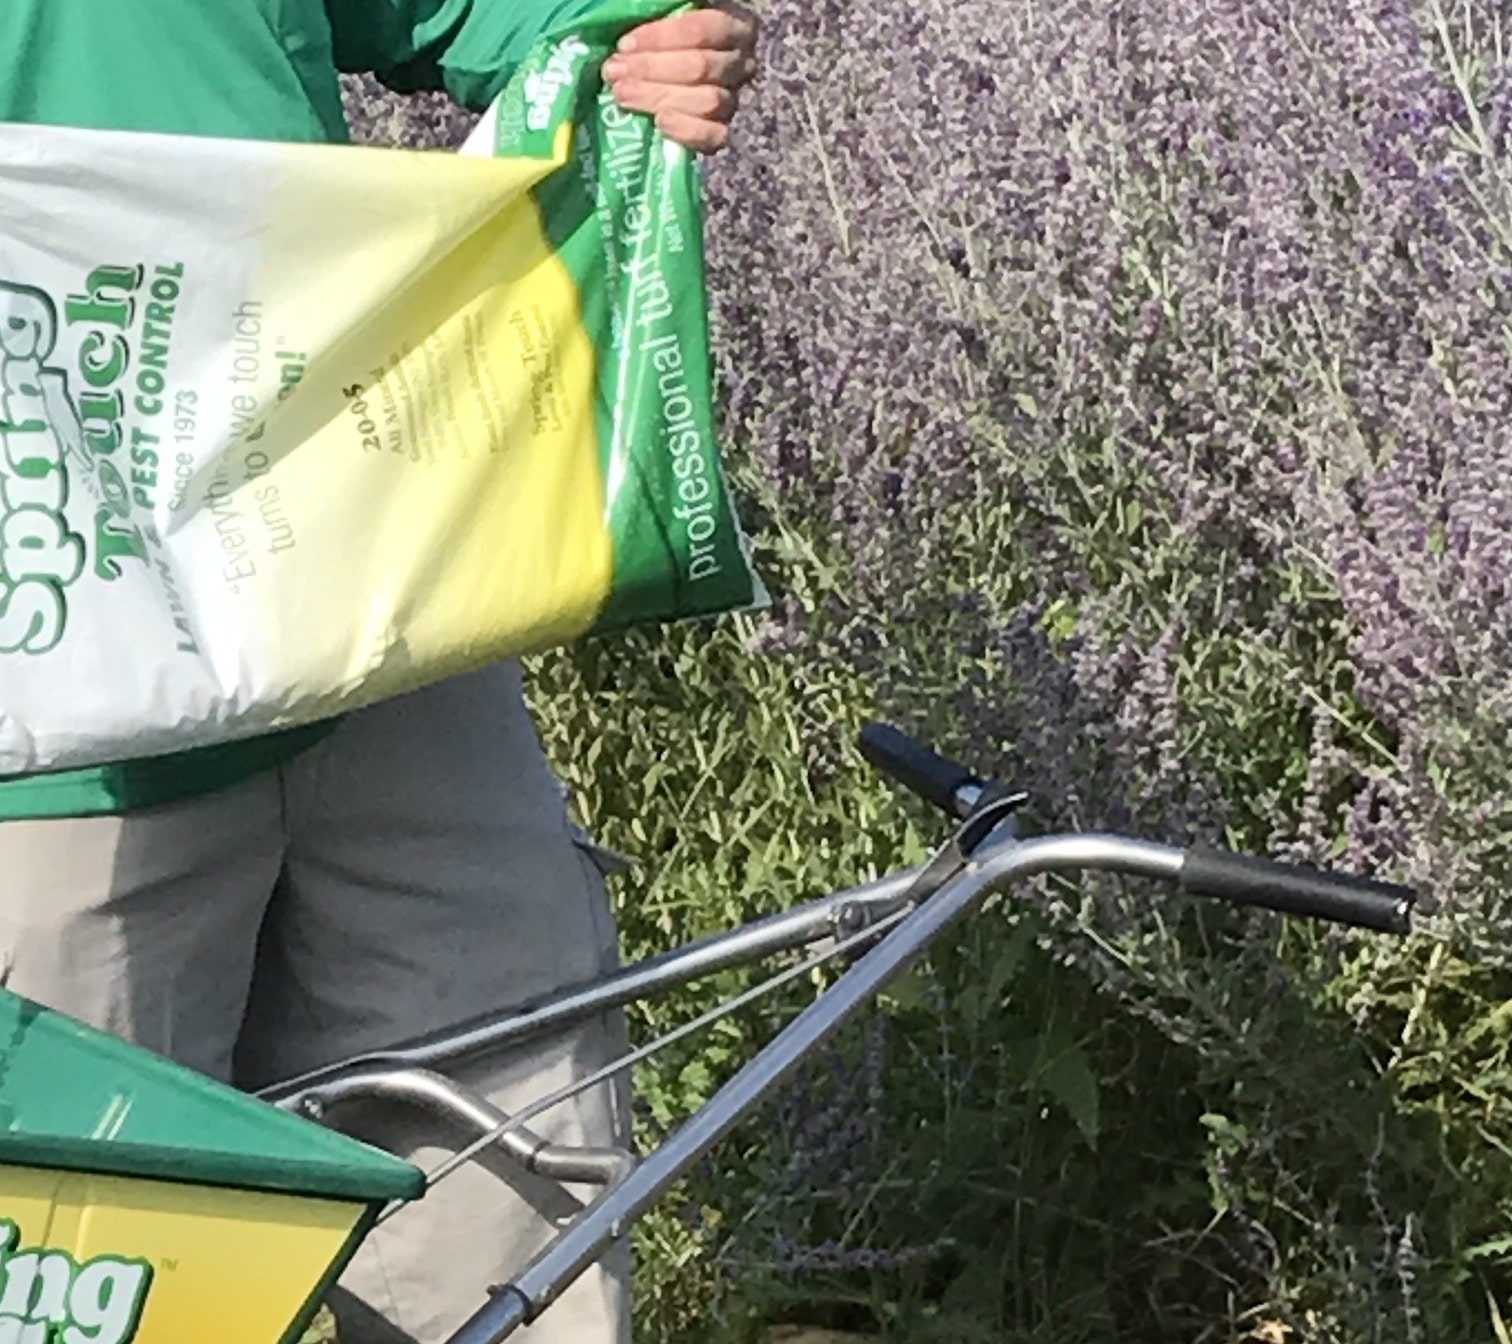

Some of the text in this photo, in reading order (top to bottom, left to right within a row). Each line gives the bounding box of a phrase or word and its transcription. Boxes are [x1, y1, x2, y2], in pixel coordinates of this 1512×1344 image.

[621, 252, 672, 326] turf
[134, 260, 185, 416] CONTROL
[228, 300, 264, 385] touch
[509, 311, 549, 437] Spring Touch
[64, 262, 150, 581] Touch
[167, 389, 198, 514] Since 1973
[230, 392, 258, 437] we
[639, 333, 720, 581] professional
[130, 427, 160, 510] PEST
[243, 449, 269, 483] to
[254, 484, 297, 556] turns
